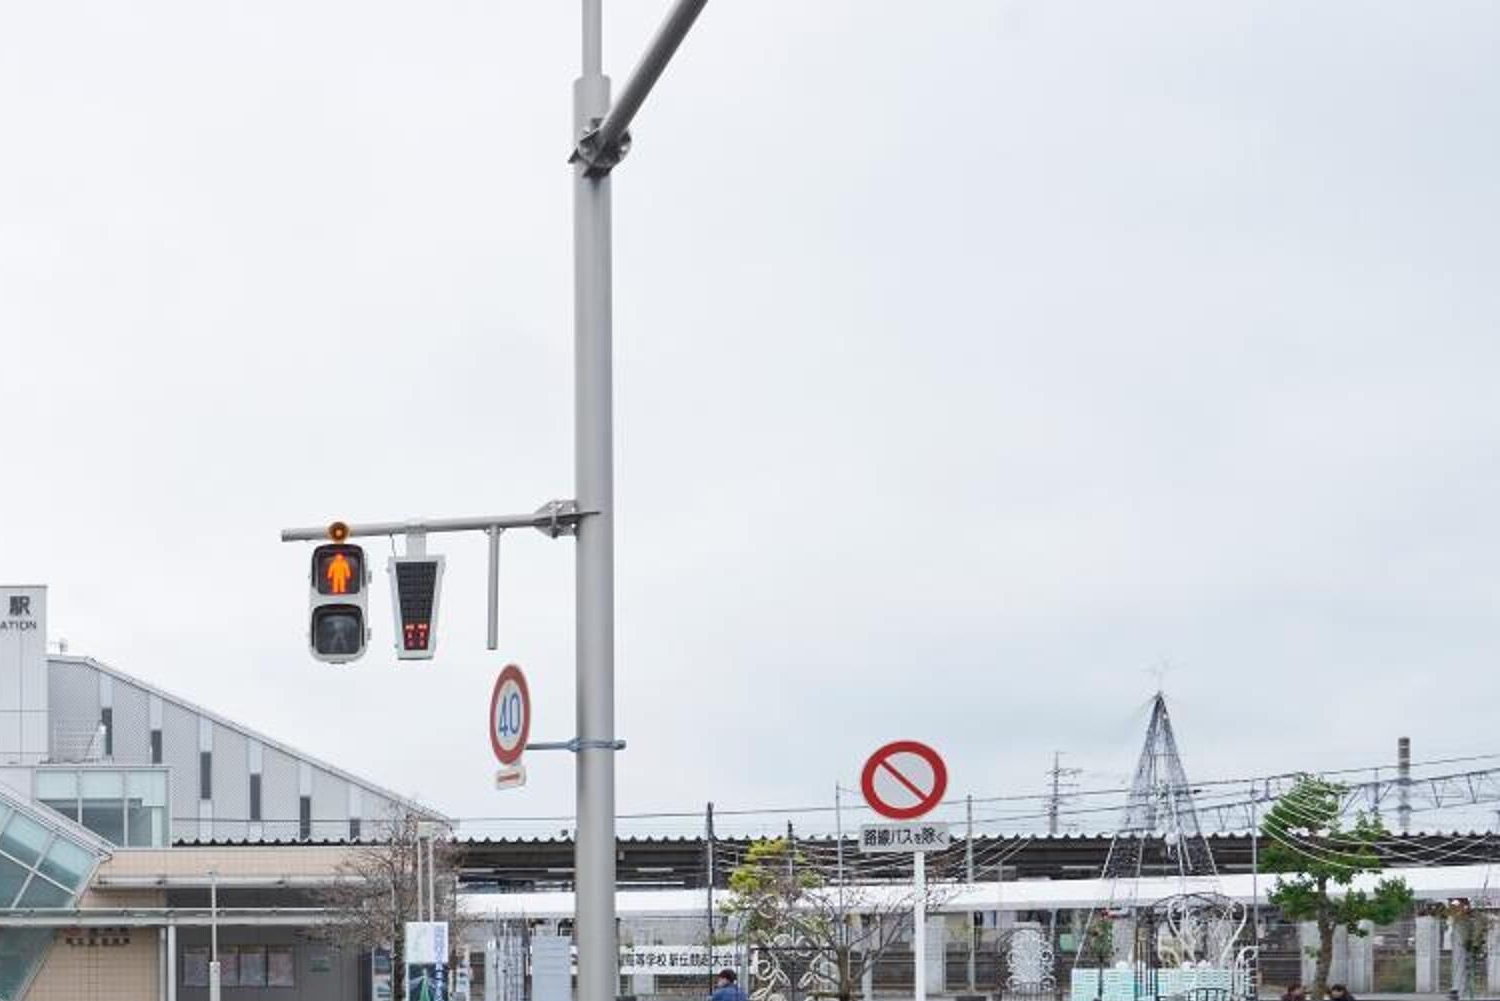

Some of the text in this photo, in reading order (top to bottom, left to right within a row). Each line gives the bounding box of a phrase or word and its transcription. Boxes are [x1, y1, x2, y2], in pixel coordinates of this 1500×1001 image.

[498, 693, 520, 736] 40
[865, 828, 945, 846] 路線バスを除く
